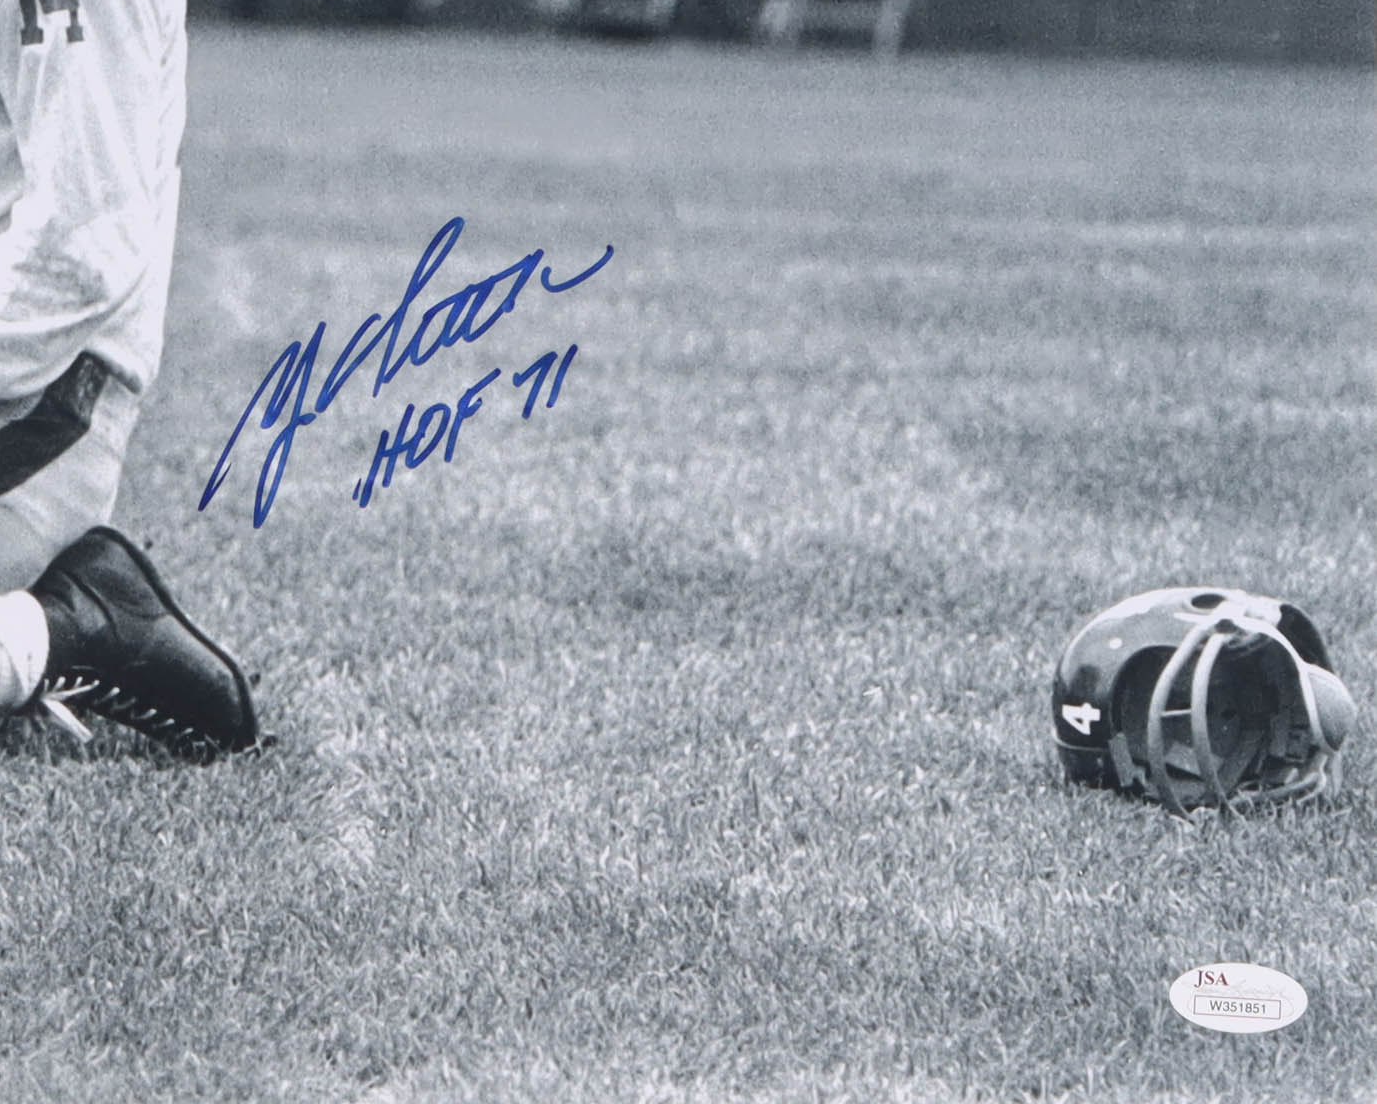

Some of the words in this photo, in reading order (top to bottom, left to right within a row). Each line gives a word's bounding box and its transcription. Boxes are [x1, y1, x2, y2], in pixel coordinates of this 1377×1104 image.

[359, 369, 500, 507] HOF
[1062, 702, 1101, 735] 4
[1193, 970, 1229, 989] JSA
[1210, 999, 1267, 1014] W351851
